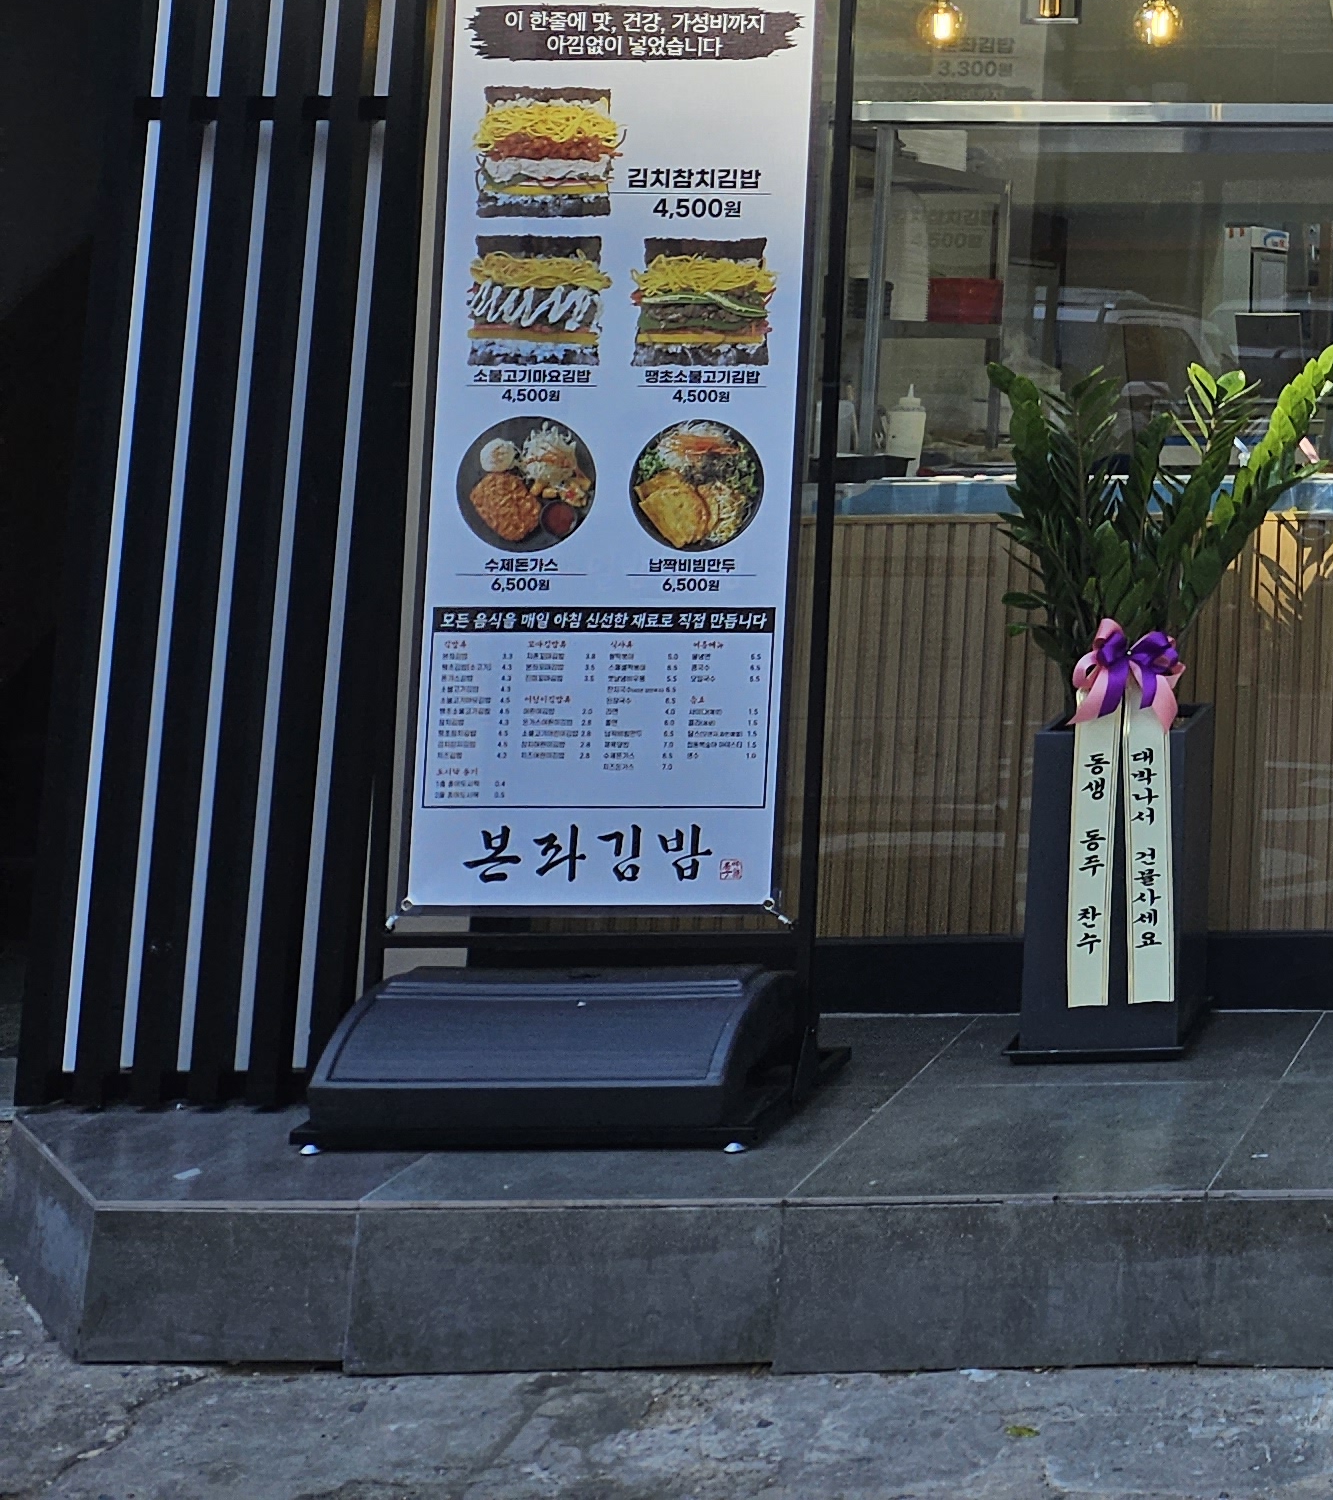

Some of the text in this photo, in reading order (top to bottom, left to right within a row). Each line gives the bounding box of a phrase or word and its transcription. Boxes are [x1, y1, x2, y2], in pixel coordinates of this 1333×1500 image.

[504, 11, 766, 35] 이 한줄에 맛, 건강, 가성비까지
[547, 35, 724, 58] 아낌없이 넣었습니다
[627, 168, 761, 190] 김치참치김밥
[652, 199, 742, 219] 4,500원
[473, 368, 591, 384] 소불고기마요김밥
[501, 389, 561, 404] 4,500원
[672, 389, 731, 404] 4,500원
[484, 557, 559, 573] 수제돈가스
[490, 576, 550, 592] 6,500원
[661, 577, 720, 593] 6,500원
[440, 612, 767, 631] 모든 음식을 매일 아침 신선한 재료로 직접 만듭니다
[1130, 747, 1159, 826] 대박나서
[463, 823, 713, 884] 본좌김밥
[1076, 752, 1110, 955] 동생 동주 찬수
